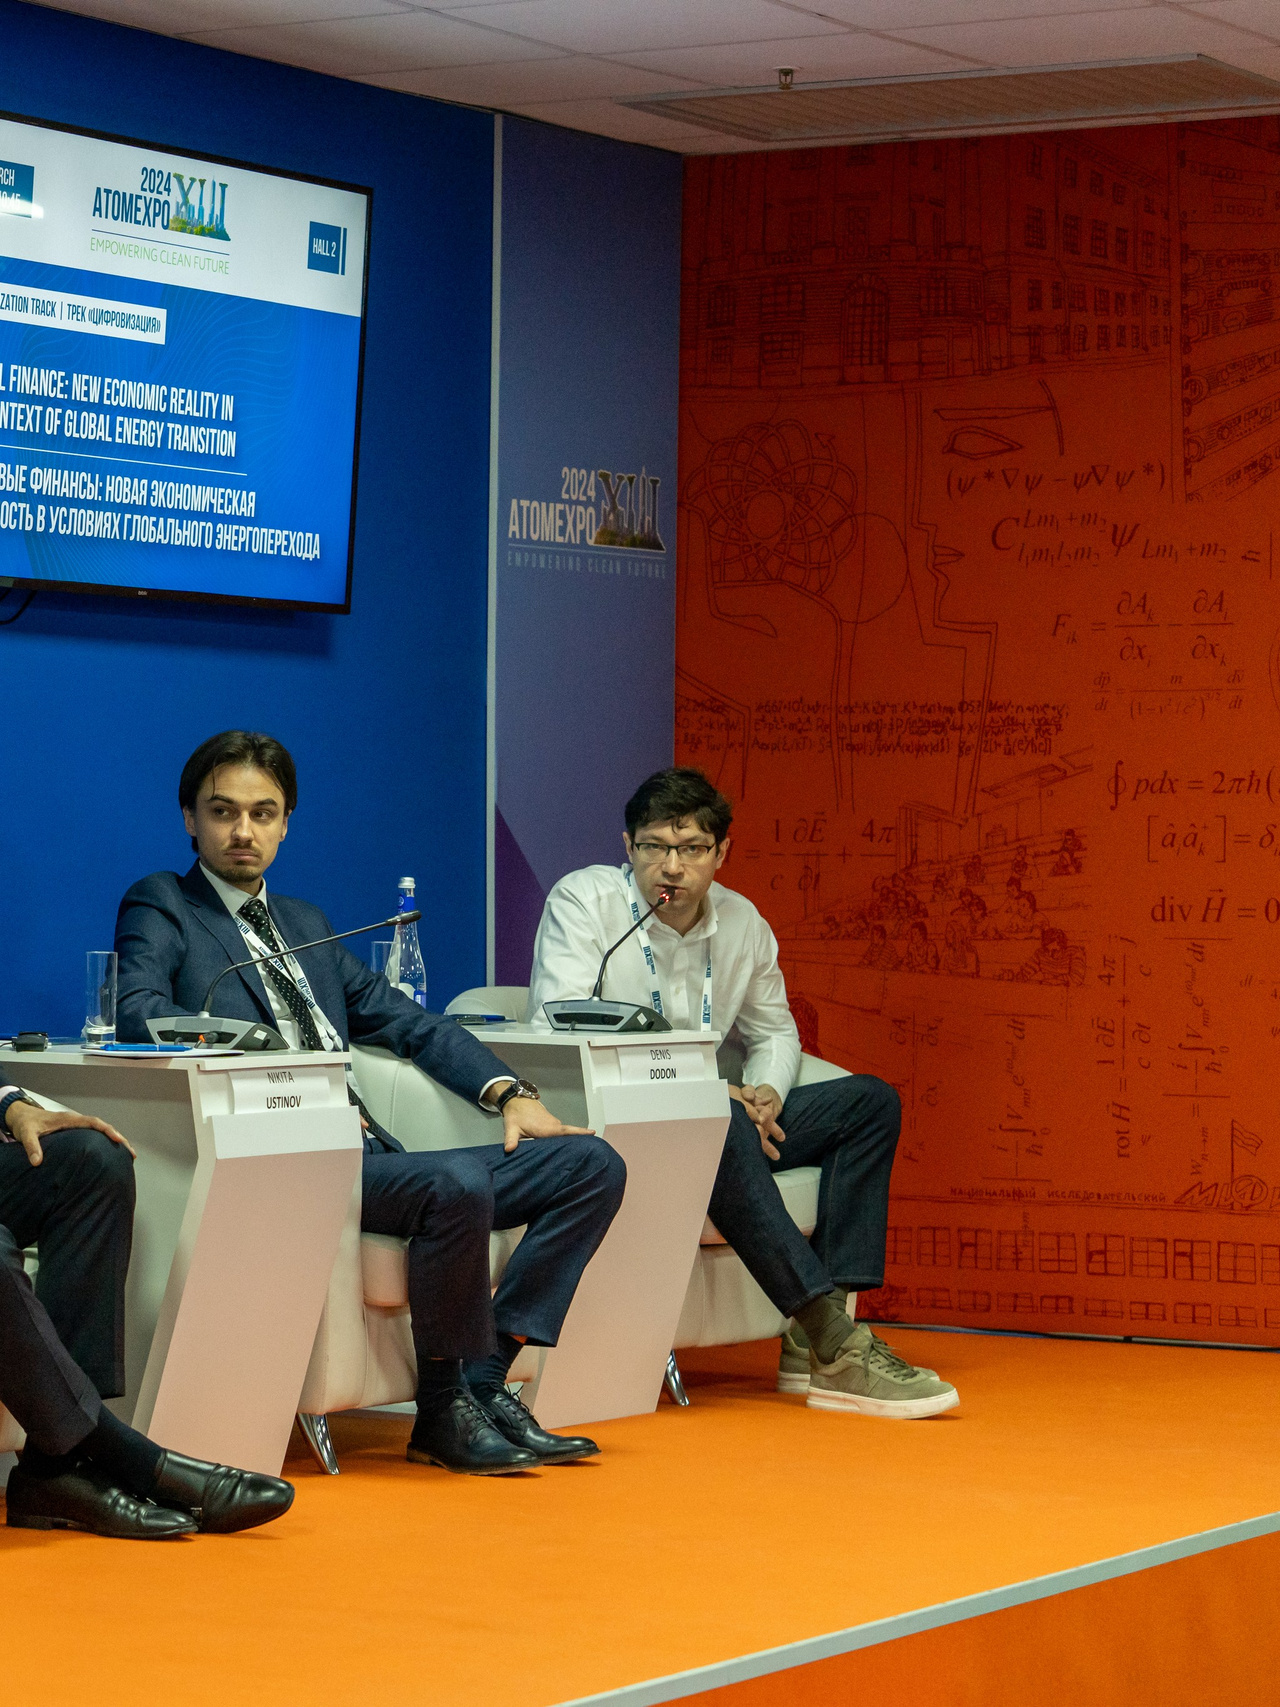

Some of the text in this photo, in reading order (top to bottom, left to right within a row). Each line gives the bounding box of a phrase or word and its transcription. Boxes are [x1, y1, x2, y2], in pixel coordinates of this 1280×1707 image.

[140, 166, 171, 197] 2024
[92, 186, 170, 231] ATOMEXPO
[90, 237, 230, 275] EMPOWERING CLEAN FUTURE
[312, 237, 336, 258] HALL 2
[31, 297, 57, 318] TRACK
[67, 303, 161, 333] ТРЕК «ЦИФРОВИЗАЦИЯ»
[9, 364, 69, 399] FINANCE:
[71, 373, 102, 403] NEW
[103, 377, 168, 413] ECONOMIC
[169, 387, 219, 420] REALITY
[221, 394, 234, 422] IN
[45, 406, 62, 436] OF
[64, 409, 112, 442] GLOBAL
[115, 416, 164, 449] ENERGY
[167, 423, 236, 457] TRANSITION
[30, 466, 103, 502] ФИНАНСЫ:
[106, 475, 147, 506] НОВАЯ
[150, 479, 256, 518] ЭКОНОМИЧЕСКАЯ
[561, 466, 596, 502] 2024
[36, 504, 45, 532] В
[49, 506, 120, 540] УСЛОВИЯХ
[123, 513, 213, 549] ГЛОБАЛЬНОГО
[215, 522, 321, 561] ЭНЕРГОПЕРЕХОДА
[508, 498, 597, 545] ATOMEXPO
[507, 551, 581, 572] EMPOWERING
[587, 558, 621, 575] CLEAN
[650, 1049, 671, 1061] DENIS
[267, 1071, 295, 1084] NIKITA
[650, 1067, 677, 1080] DODON
[266, 1095, 302, 1109] USTINOV
